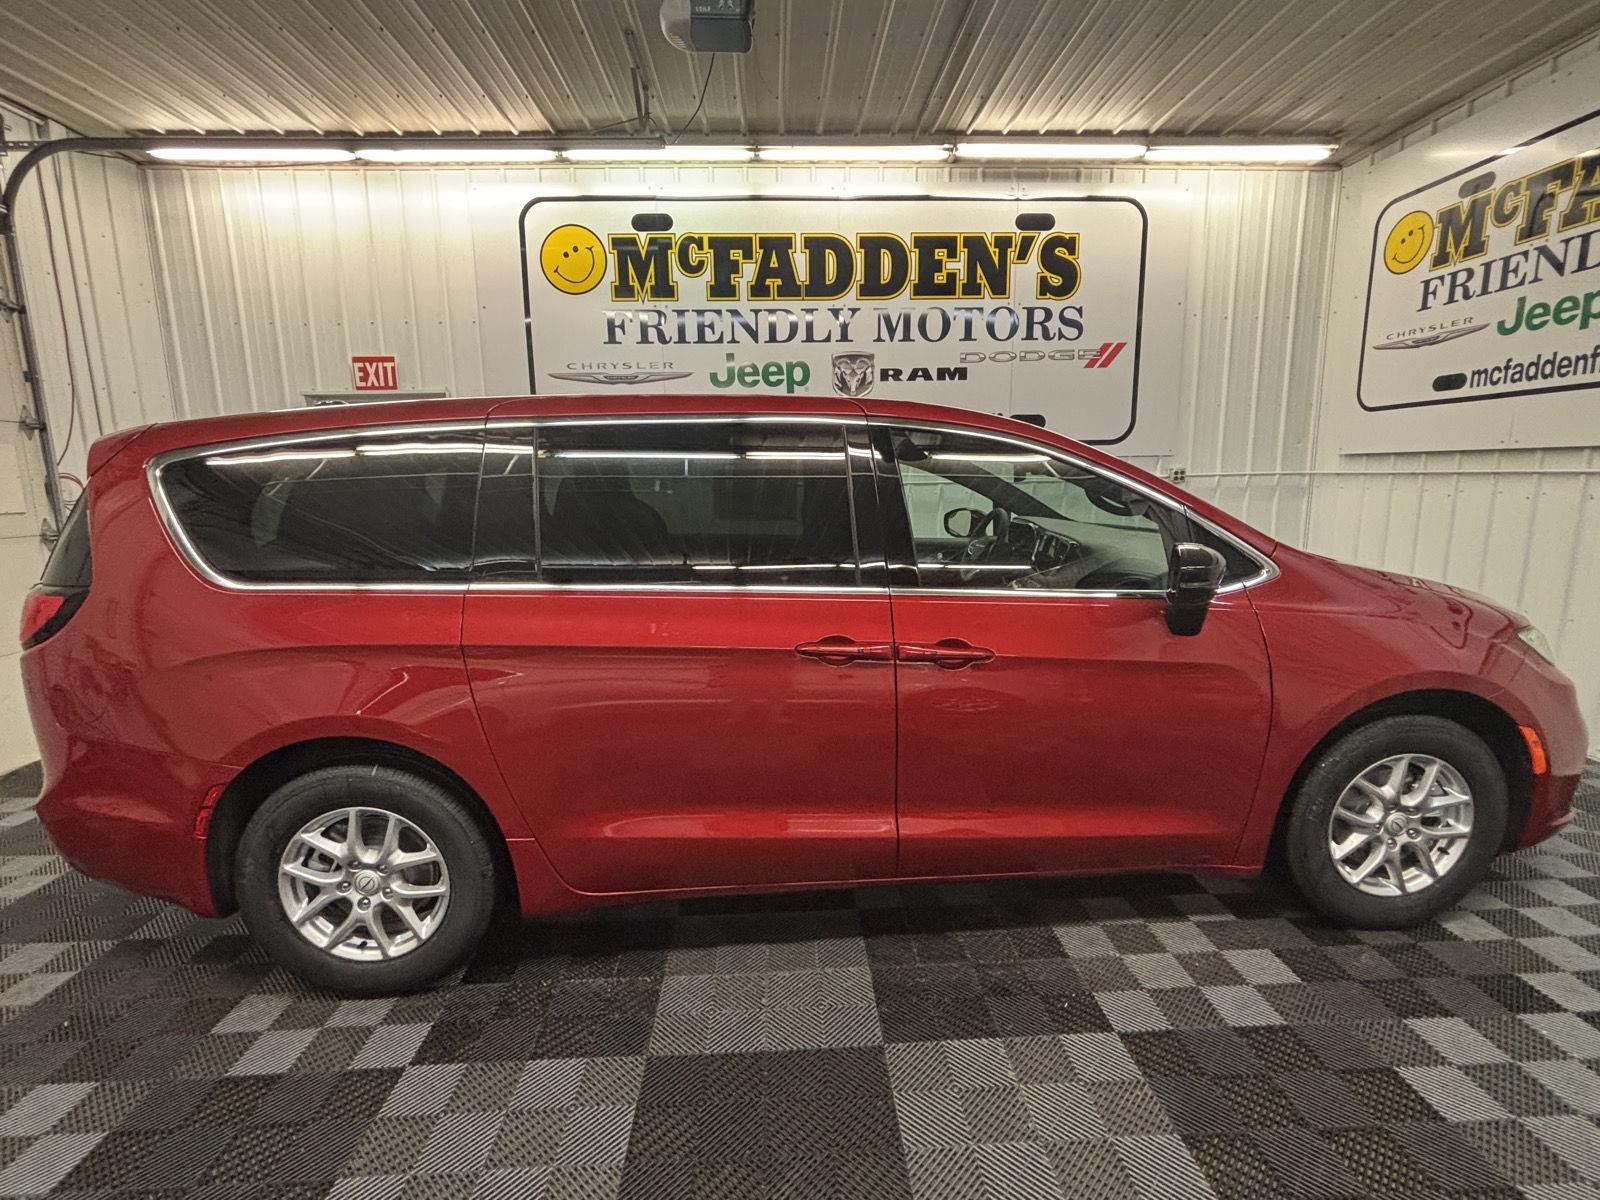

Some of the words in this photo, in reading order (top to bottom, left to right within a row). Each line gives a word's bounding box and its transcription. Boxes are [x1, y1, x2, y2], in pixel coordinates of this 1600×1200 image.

[601, 307, 861, 345] FRIENDLY
[872, 305, 1085, 343] MOTORS
[1386, 316, 1475, 340] CHRYSLER
[566, 361, 675, 370] CHRYSLER
[959, 349, 1102, 363] DODGE
[1469, 344, 1600, 389] mcfaddenf
[353, 362, 395, 387] EXIT
[880, 367, 968, 382] RAM
